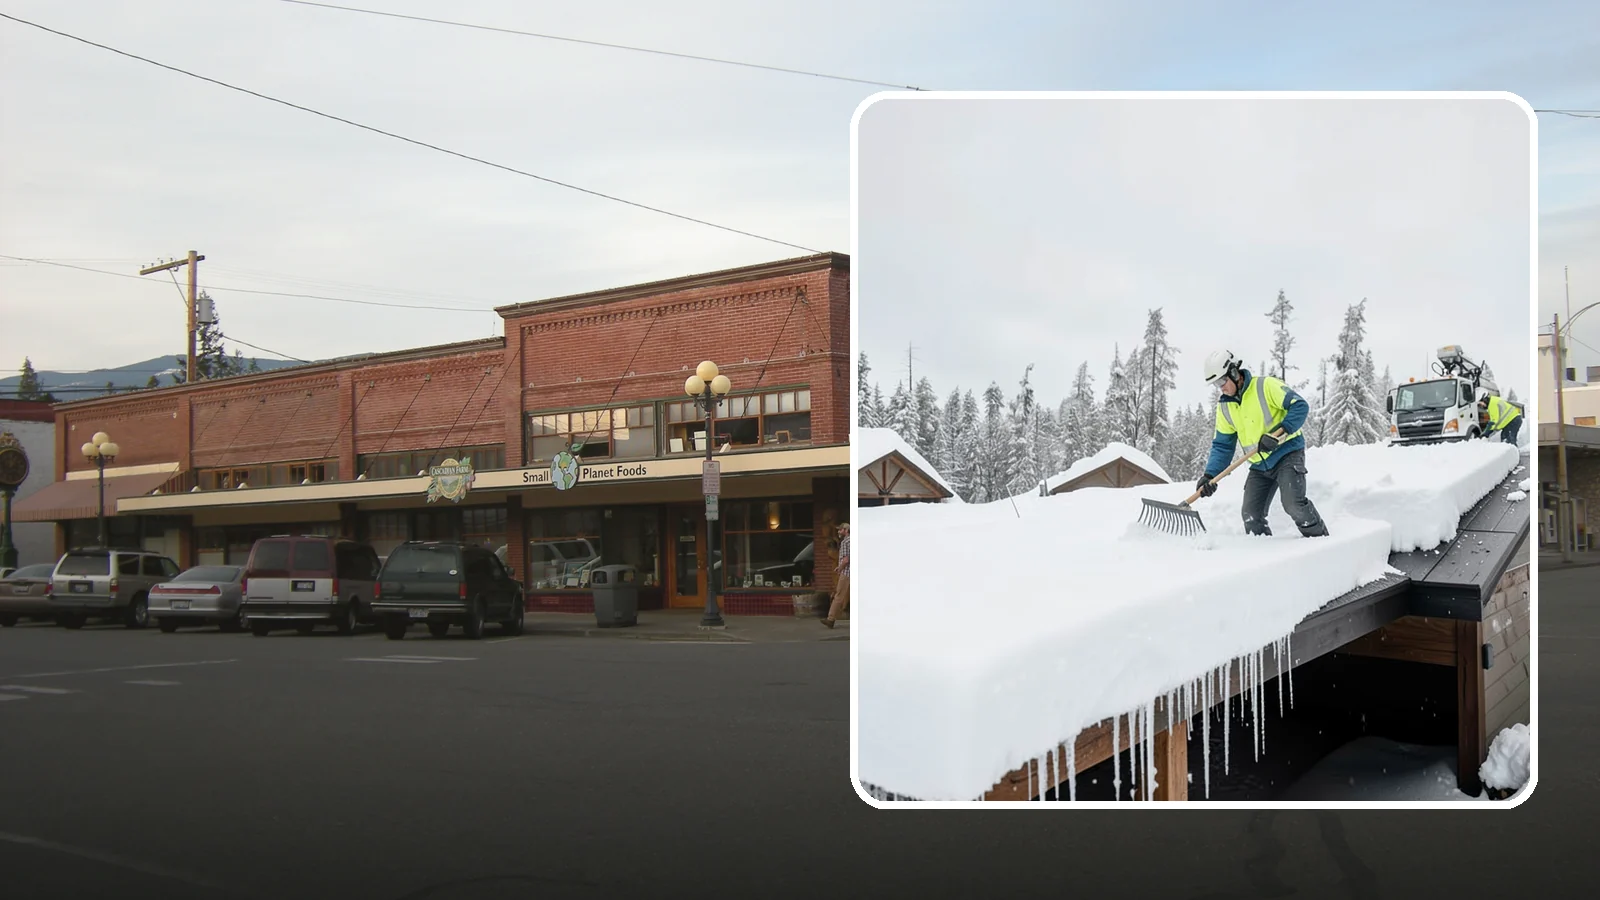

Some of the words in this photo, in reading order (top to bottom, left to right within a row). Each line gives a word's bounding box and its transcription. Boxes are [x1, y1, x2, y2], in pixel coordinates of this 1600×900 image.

[523, 470, 549, 483] Small
[582, 467, 614, 479] Planet
[616, 464, 647, 477] Foods
